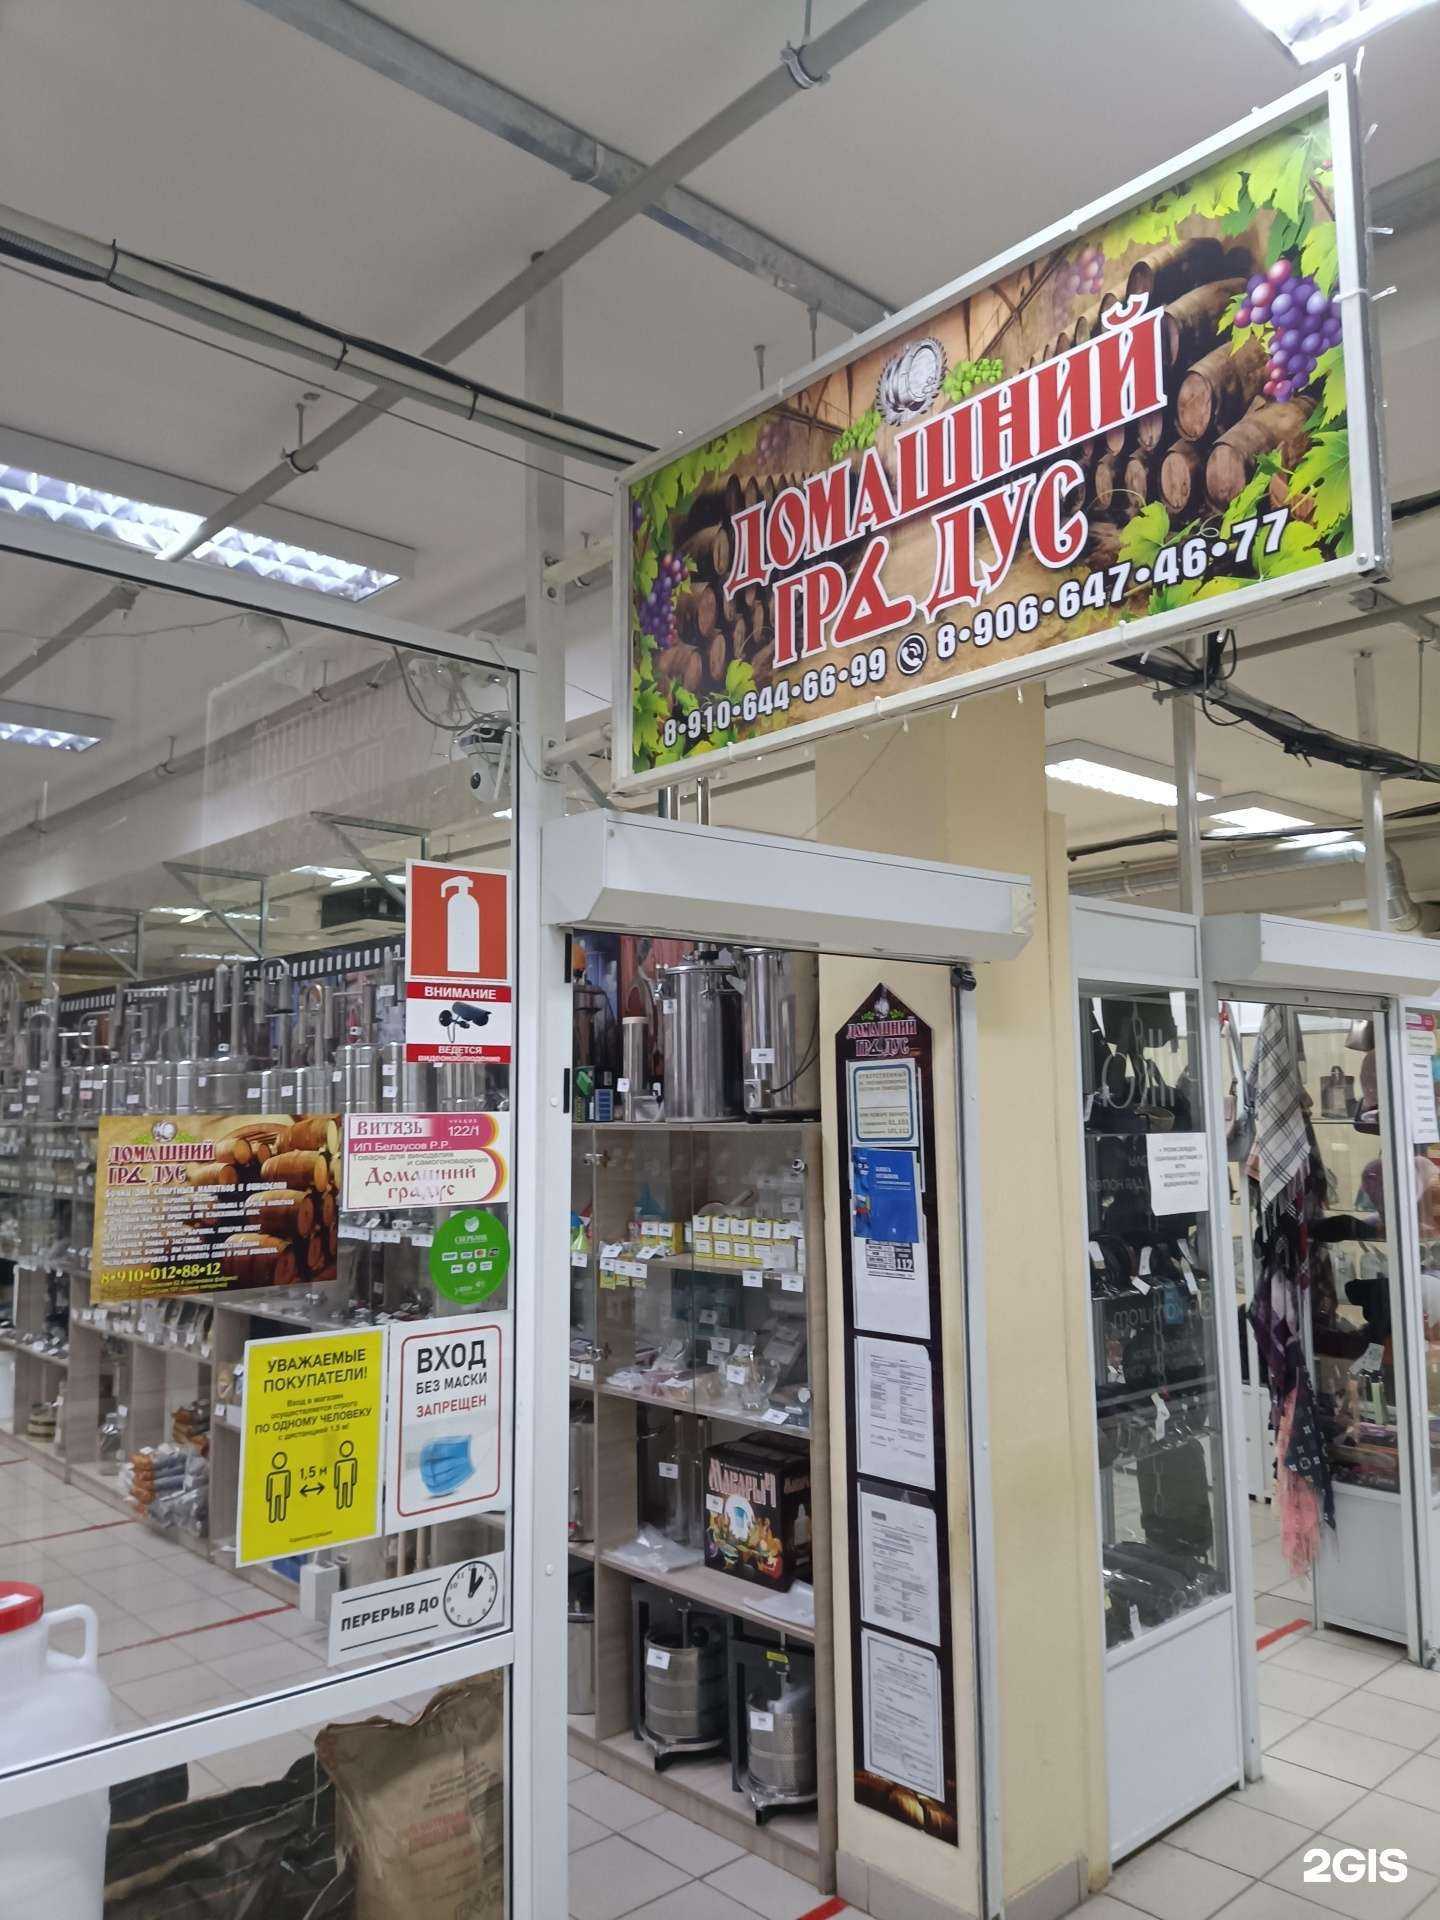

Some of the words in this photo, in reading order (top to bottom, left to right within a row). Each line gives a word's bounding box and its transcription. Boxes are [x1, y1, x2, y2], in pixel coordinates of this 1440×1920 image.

[725, 293, 1167, 598] ДОМАШНИЙ
[424, 986, 497, 1000] ВНИМАНИЕ
[846, 1015, 917, 1039] ДОМАШНИЙ
[438, 1045, 482, 1055] ВЕДЕТСЯ
[357, 1121, 423, 1136] ВИТЯЗЬ
[448, 1125, 479, 1137] 122/1
[108, 1141, 215, 1165] ДОМАШНИЙ
[353, 1142, 372, 1152] ИП
[375, 1141, 427, 1153] Белоусов
[267, 1348, 367, 1374] УВАЖАЕМЫЕ
[416, 1339, 486, 1374] ВХОД
[263, 1366, 368, 1393] ПОКУПАТЕЛИ!
[416, 1381, 440, 1395] БЕЗ
[444, 1371, 488, 1391] МАСКИ
[416, 1394, 487, 1418] ЗАПРЕЩЕН
[255, 1423, 270, 1435] ПО
[272, 1415, 318, 1432] ОДНОМУ
[320, 1407, 372, 1424] ЧЕЛОВЕКУ
[299, 1465, 316, 1481] 1,5
[341, 1603, 415, 1632] ПЕРЕРЫВ
[418, 1596, 439, 1615] ДО
